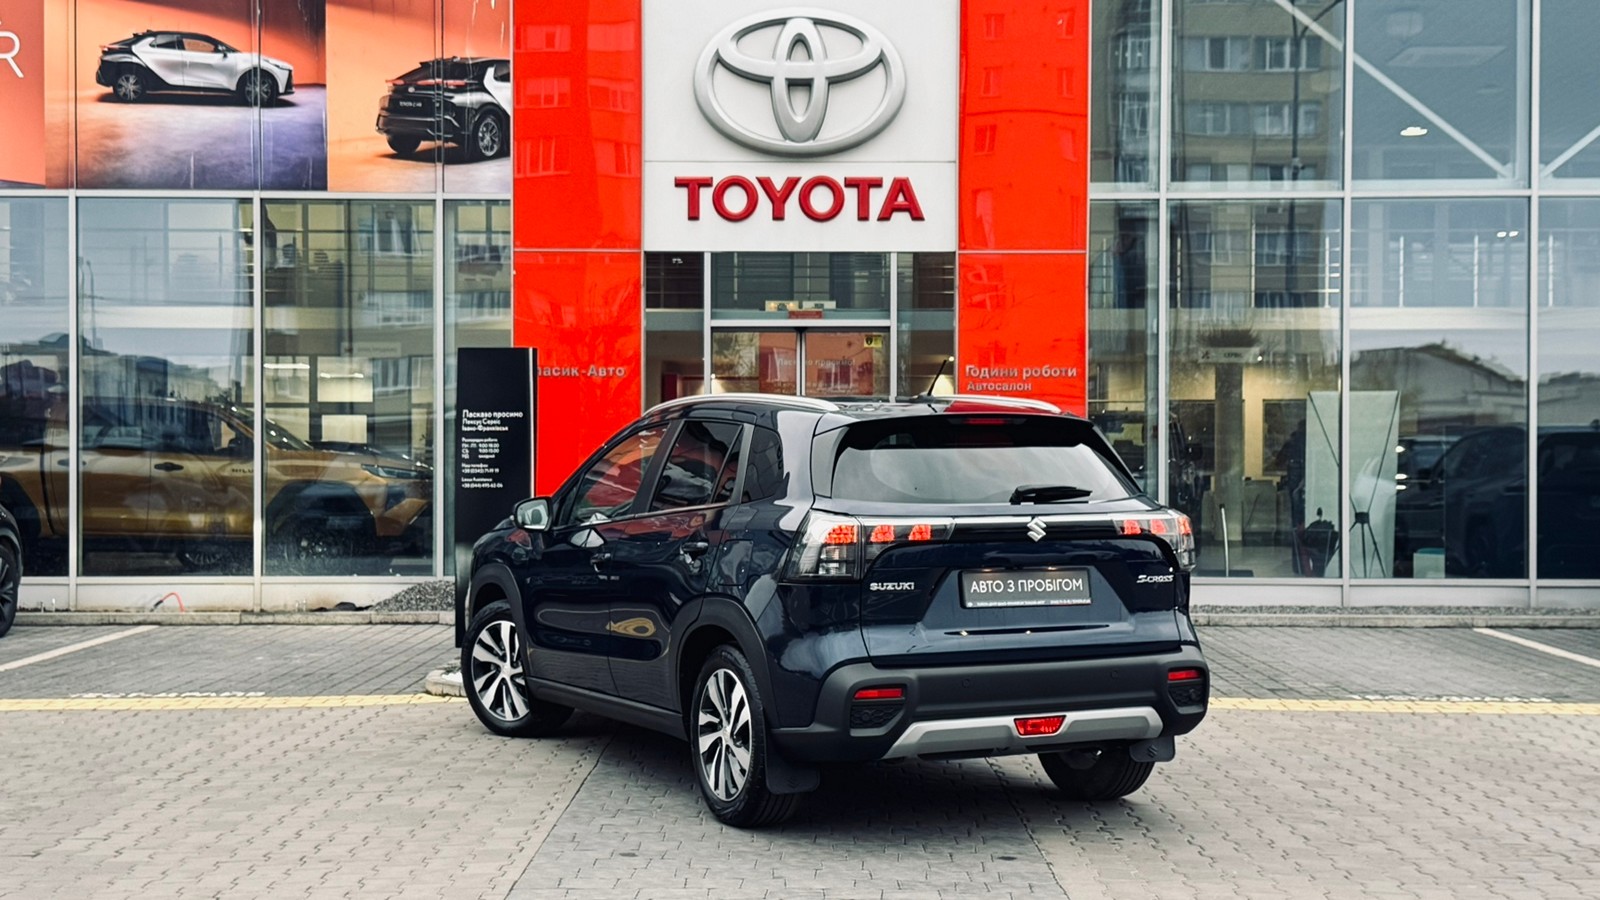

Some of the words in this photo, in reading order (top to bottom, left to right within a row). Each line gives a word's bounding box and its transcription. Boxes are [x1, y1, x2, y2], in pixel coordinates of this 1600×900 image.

[674, 175, 925, 222] TOYOTA
[965, 365, 1018, 379] Години
[1023, 365, 1077, 380] роботи
[967, 381, 1032, 391] Автосалон
[493, 411, 524, 419] просимо
[869, 582, 915, 591] SUZUKI
[970, 580, 1004, 593] АВТО
[1018, 578, 1083, 592] ПРОБІГОМ
